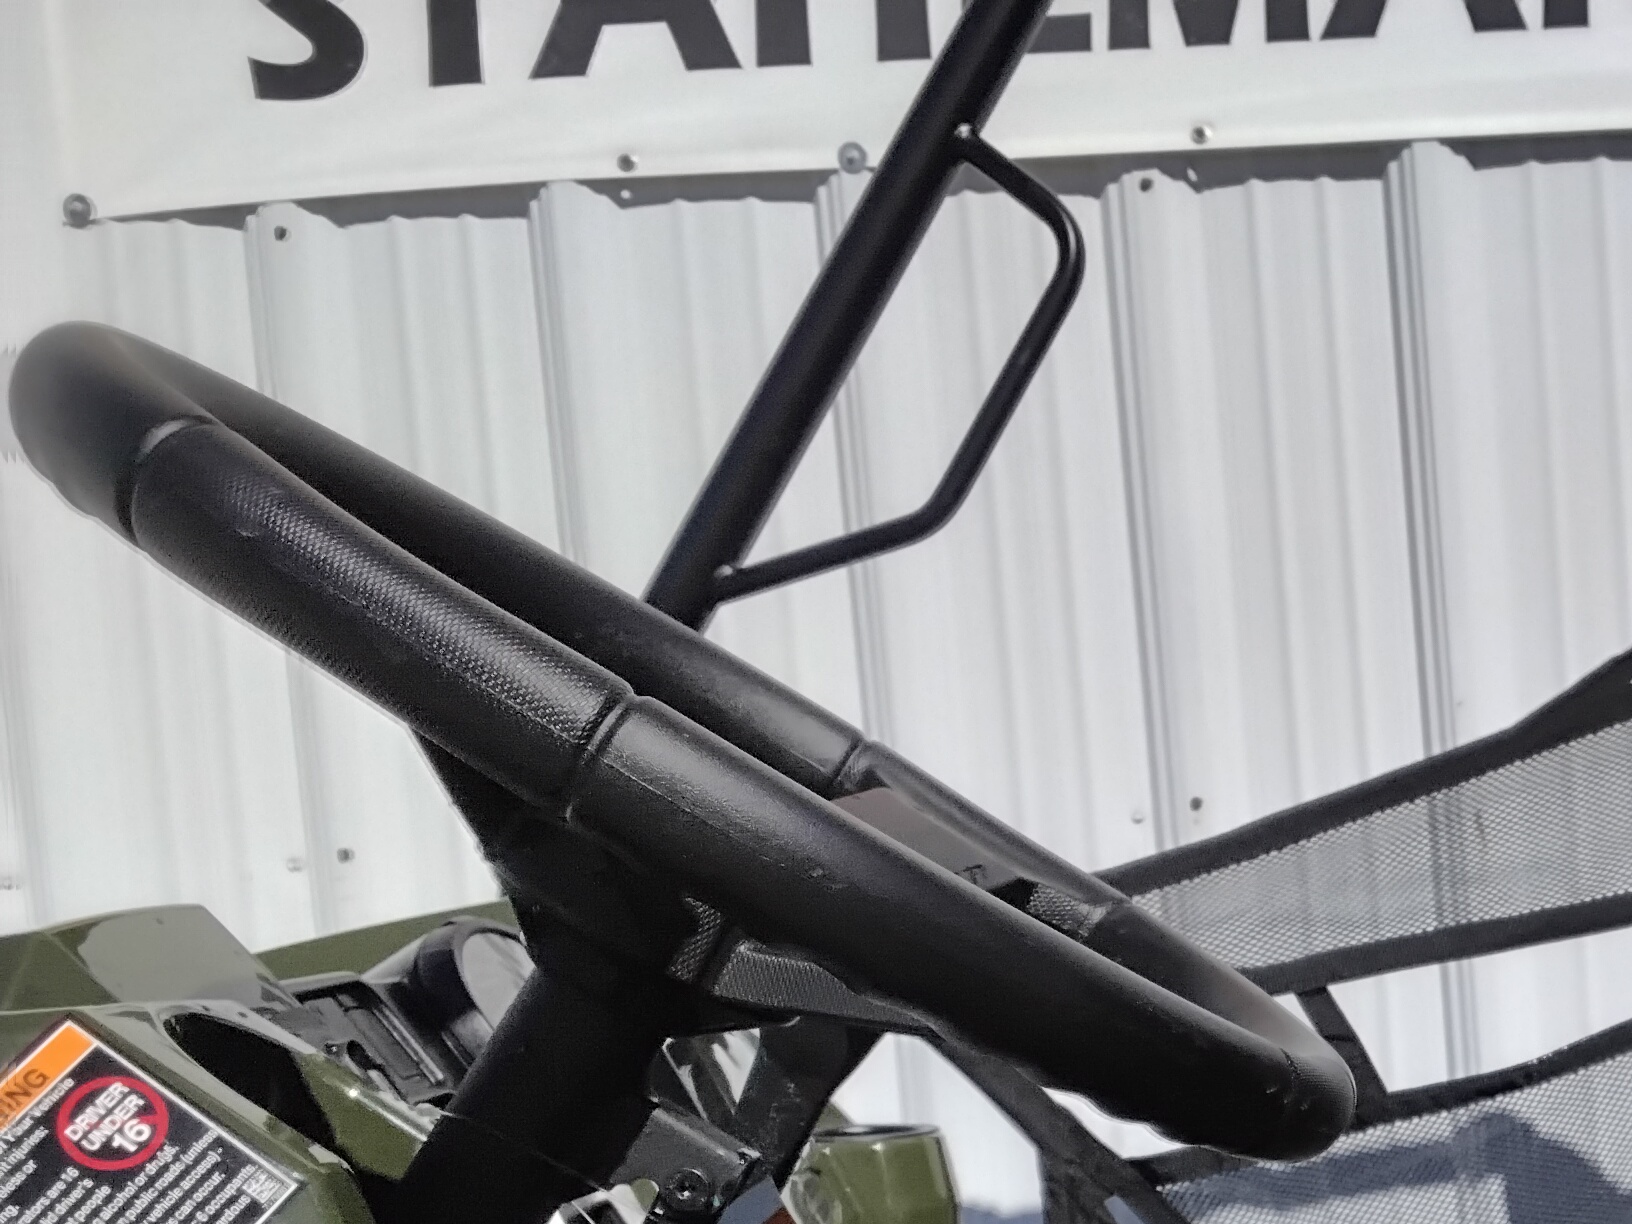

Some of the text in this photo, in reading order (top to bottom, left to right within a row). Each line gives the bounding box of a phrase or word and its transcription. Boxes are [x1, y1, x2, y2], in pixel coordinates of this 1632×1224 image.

[3, 1077, 75, 1143] Your Vehicle
[63, 1081, 130, 1141] DRIVER
[80, 1094, 145, 1151] UNDER
[111, 1118, 152, 1153] 16
[21, 1159, 37, 1174] or
[46, 1181, 67, 1199] are
[60, 1166, 80, 1182] 16
[99, 1181, 139, 1222] alcohol
[134, 1171, 149, 1187] or
[144, 1141, 180, 1176] drugs.
[124, 1187, 159, 1222] public
[154, 1161, 186, 1191] roads
[179, 1129, 219, 1165] (unless
[145, 1187, 184, 1223] vehicle
[179, 1150, 222, 1191] access)
[195, 1210, 209, 1222] 6
[204, 1163, 259, 1216] occupants.
[54, 1178, 95, 1216] driver's
[73, 1185, 112, 1223] people
[174, 1199, 197, 1220] can
[192, 1171, 226, 1202] occur.
